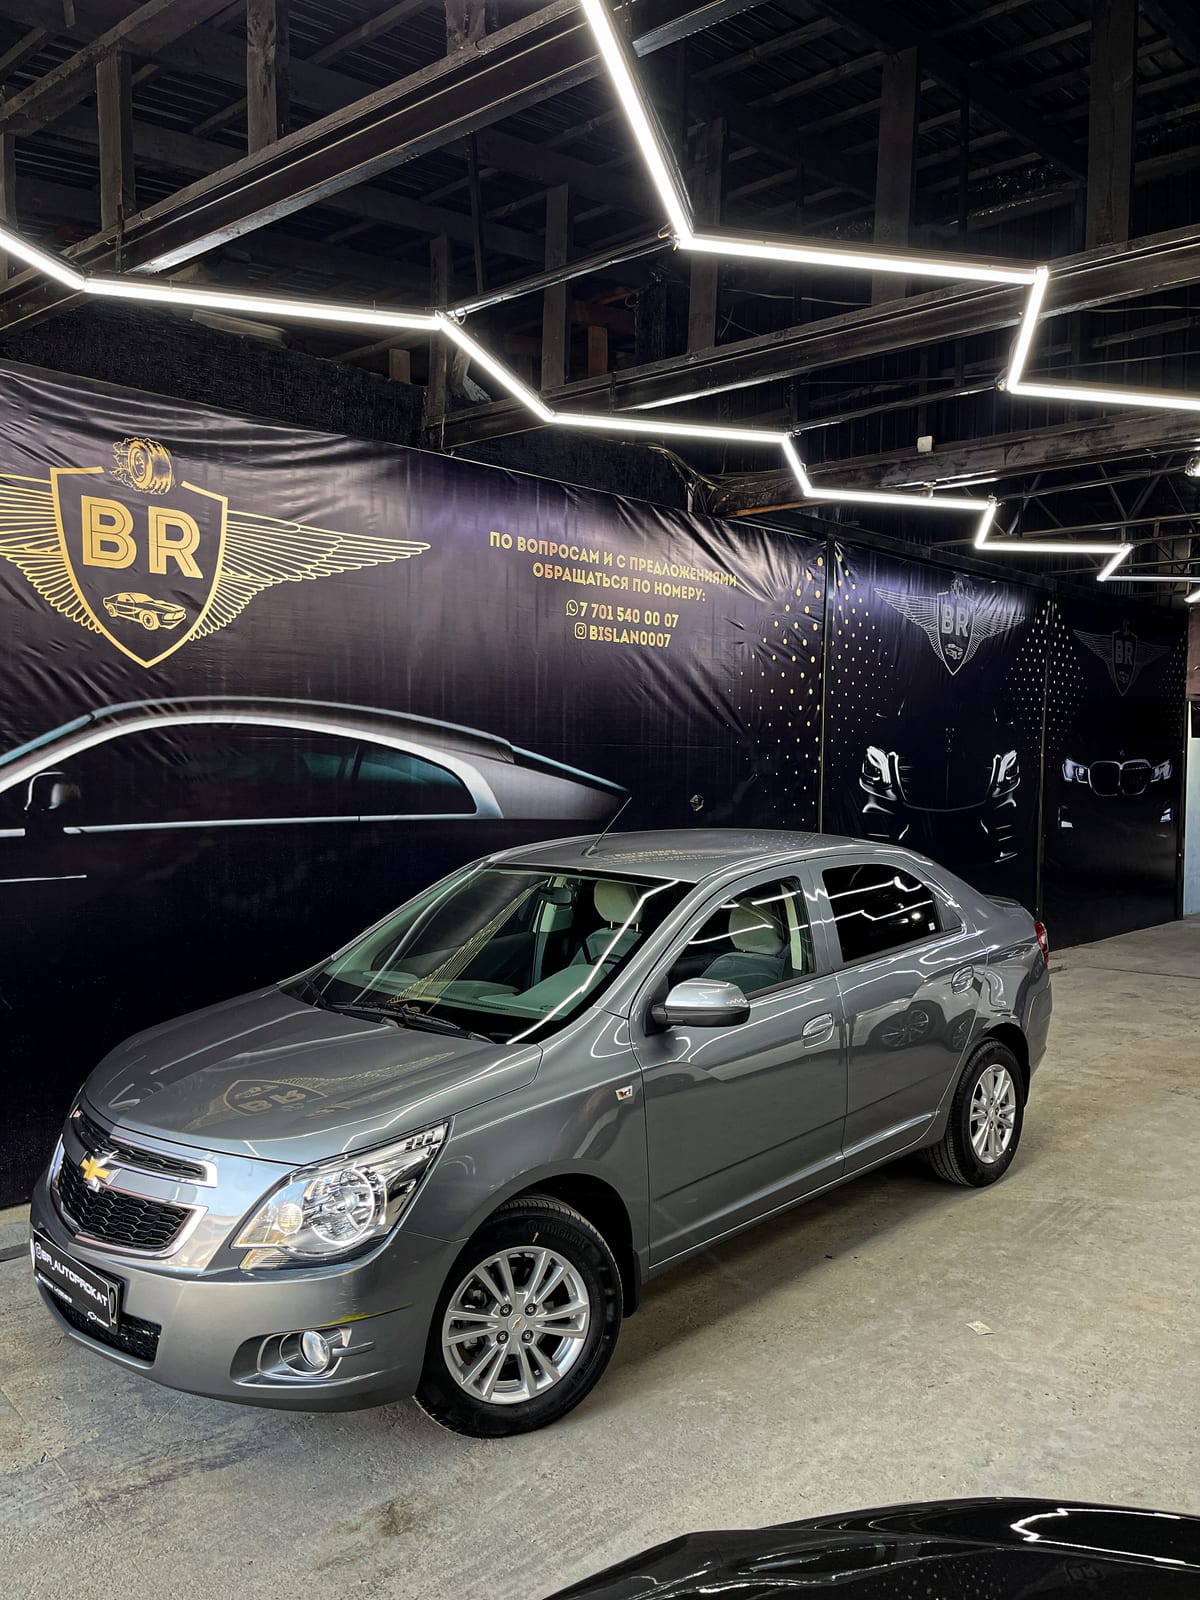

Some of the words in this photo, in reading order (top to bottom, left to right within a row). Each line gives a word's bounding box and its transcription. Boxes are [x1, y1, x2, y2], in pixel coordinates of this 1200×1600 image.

[80, 495, 204, 579] BR
[489, 531, 513, 549] ПО
[517, 536, 600, 565] ВОПРОСАМ
[603, 551, 613, 567] И
[616, 554, 626, 569] С
[629, 556, 738, 588] ПРЕДЛОЖЕНИЯМИ
[532, 562, 629, 591] ОБРАЩАТЬСЯ
[632, 578, 651, 595] ПО
[654, 581, 706, 602] НОМЕРУ:
[579, 602, 588, 617] 7
[591, 603, 613, 621] 701
[617, 607, 640, 624] 540
[644, 610, 660, 627] 00
[664, 613, 679, 628] 07
[940, 604, 969, 637] BR
[589, 625, 672, 648] BISLAN0007
[1115, 639, 1133, 666] BR
